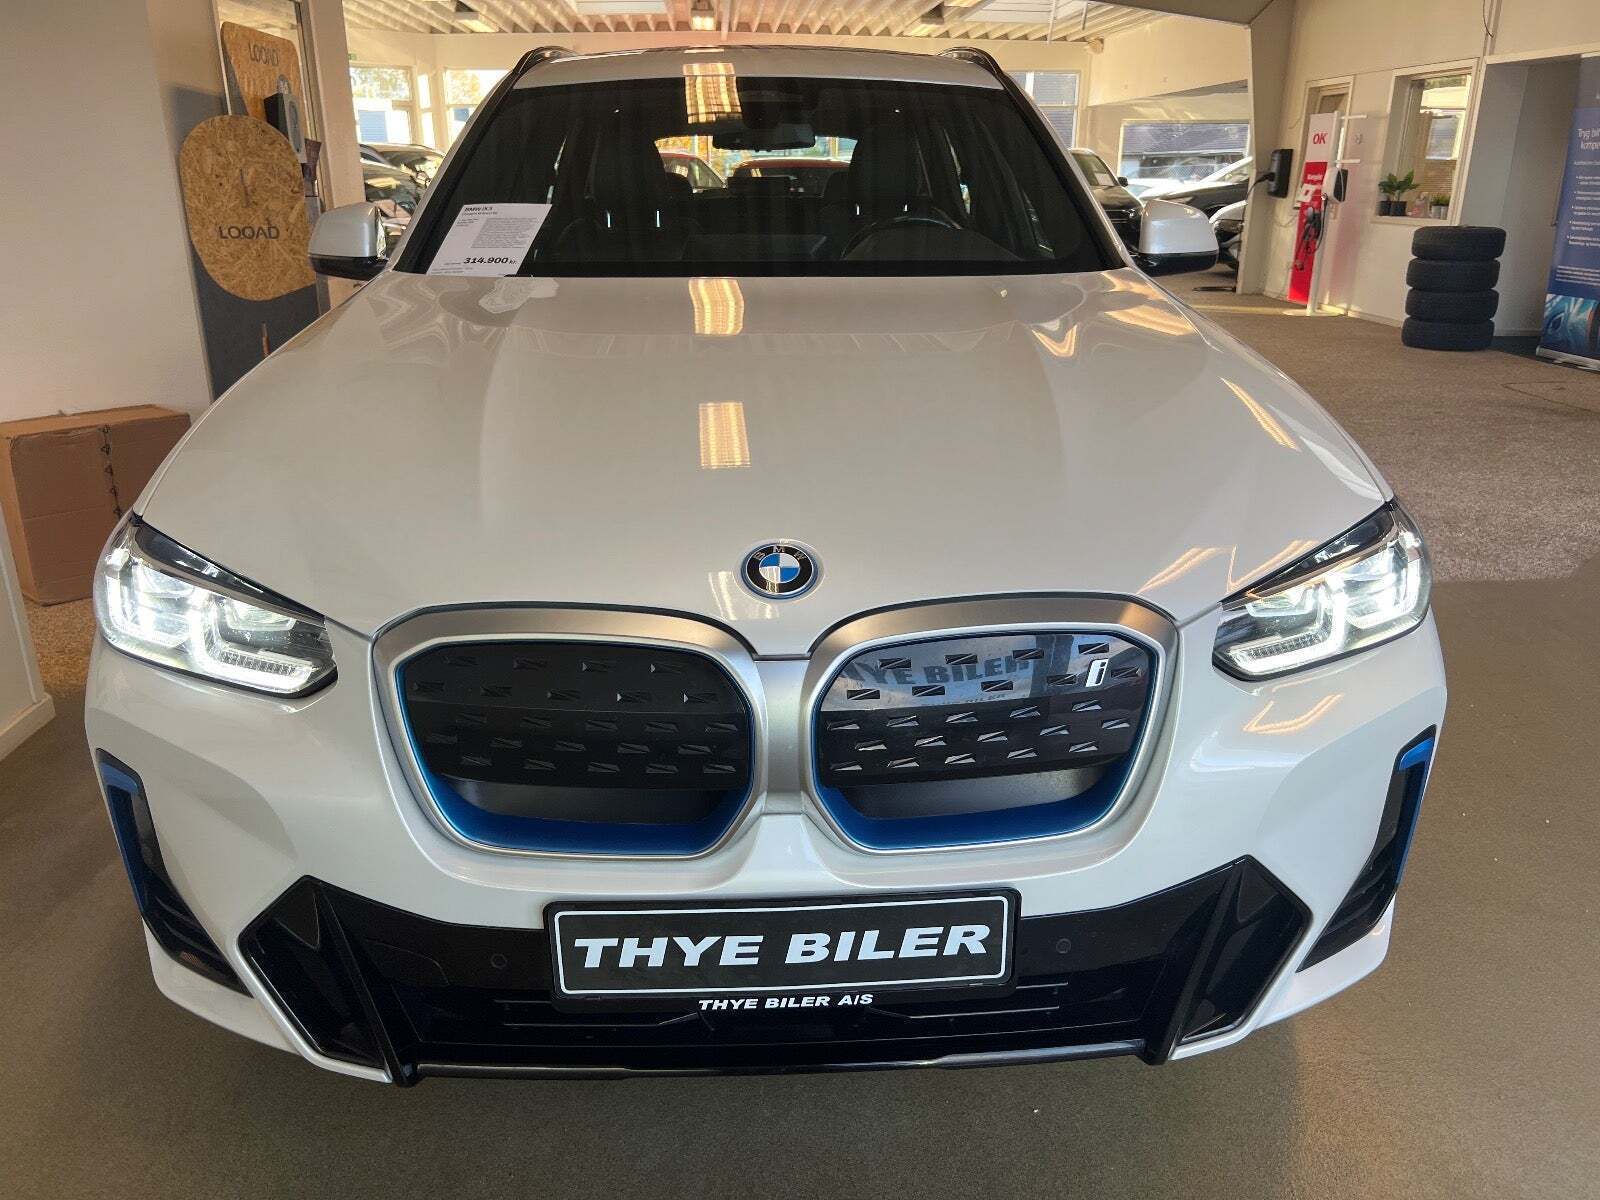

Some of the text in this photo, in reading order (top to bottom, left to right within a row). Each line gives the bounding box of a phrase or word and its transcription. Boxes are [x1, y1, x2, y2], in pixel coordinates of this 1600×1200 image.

[1312, 132, 1328, 145] OK
[219, 226, 280, 240] LOOAD
[463, 257, 509, 265] 314.900
[753, 543, 806, 561] BMW
[574, 924, 990, 968] THYE BILER
[698, 993, 874, 1010] THYE BILER A/S
